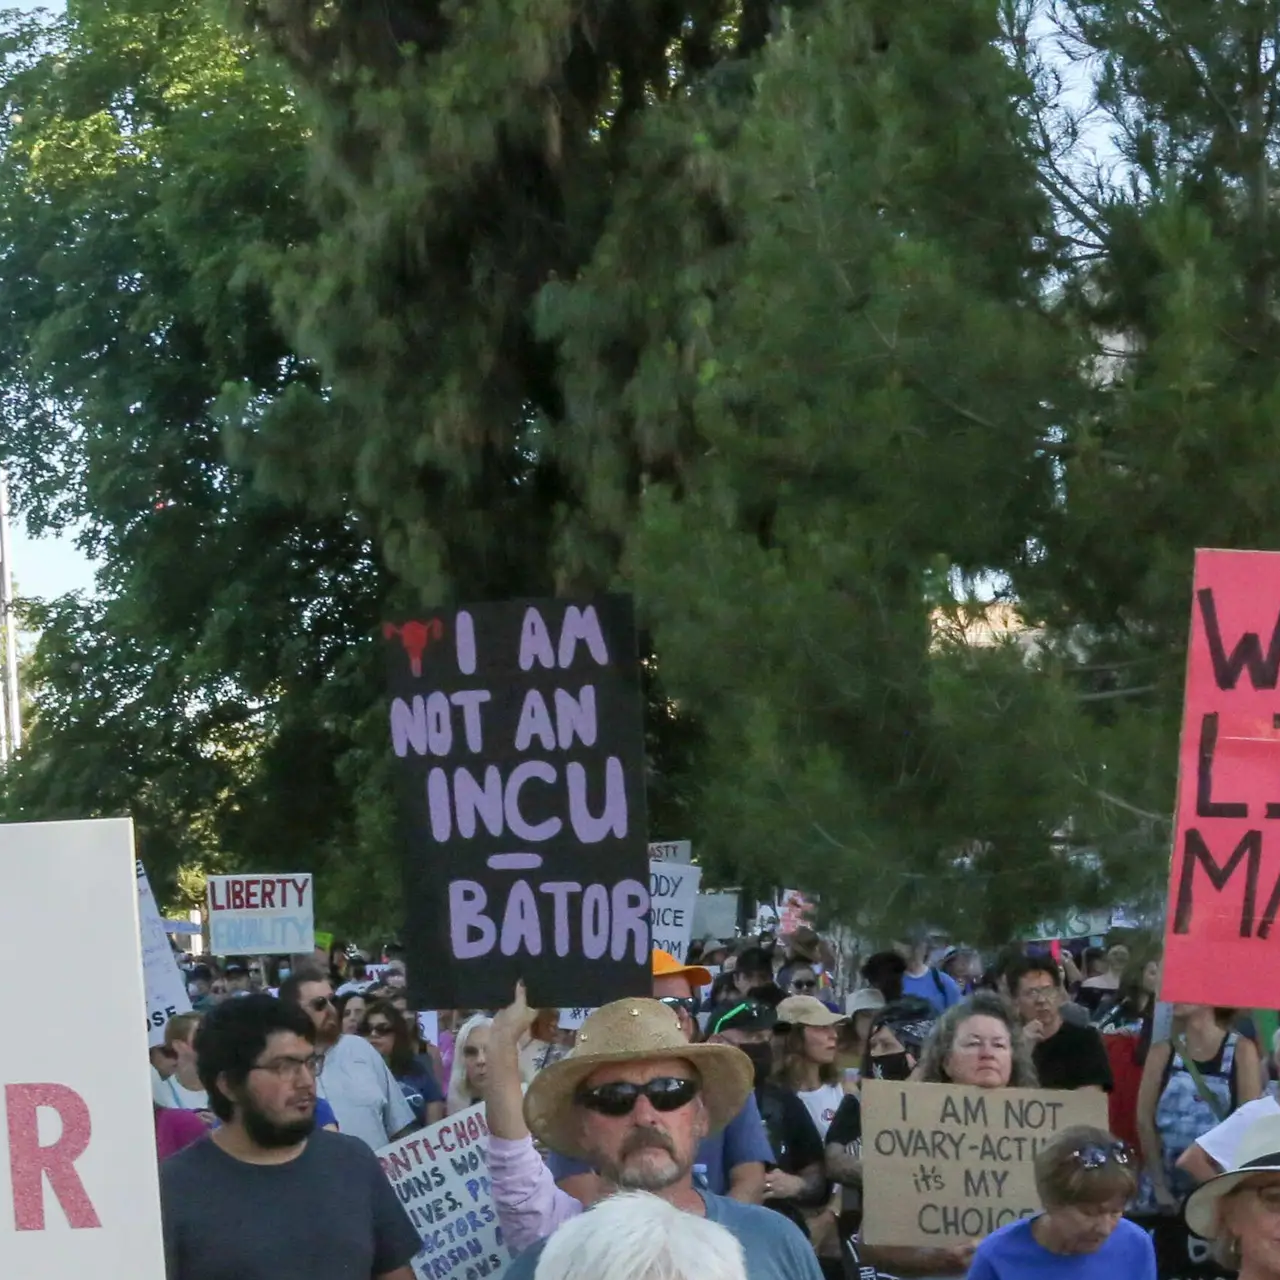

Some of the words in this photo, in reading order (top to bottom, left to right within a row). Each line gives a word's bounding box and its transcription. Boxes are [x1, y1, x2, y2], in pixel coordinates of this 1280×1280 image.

[455, 609, 477, 675] I
[519, 604, 609, 671] AM
[390, 689, 491, 757] NOT
[515, 684, 598, 750] AN
[427, 756, 628, 843] INCU
[209, 878, 309, 911] LIBERTY
[448, 879, 651, 965] BATOR
[900, 1092, 908, 1121] I
[940, 1096, 988, 1126] AM
[1004, 1100, 1063, 1130] NOT
[912, 1164, 946, 1194] it's
[964, 1170, 1009, 1198] MY
